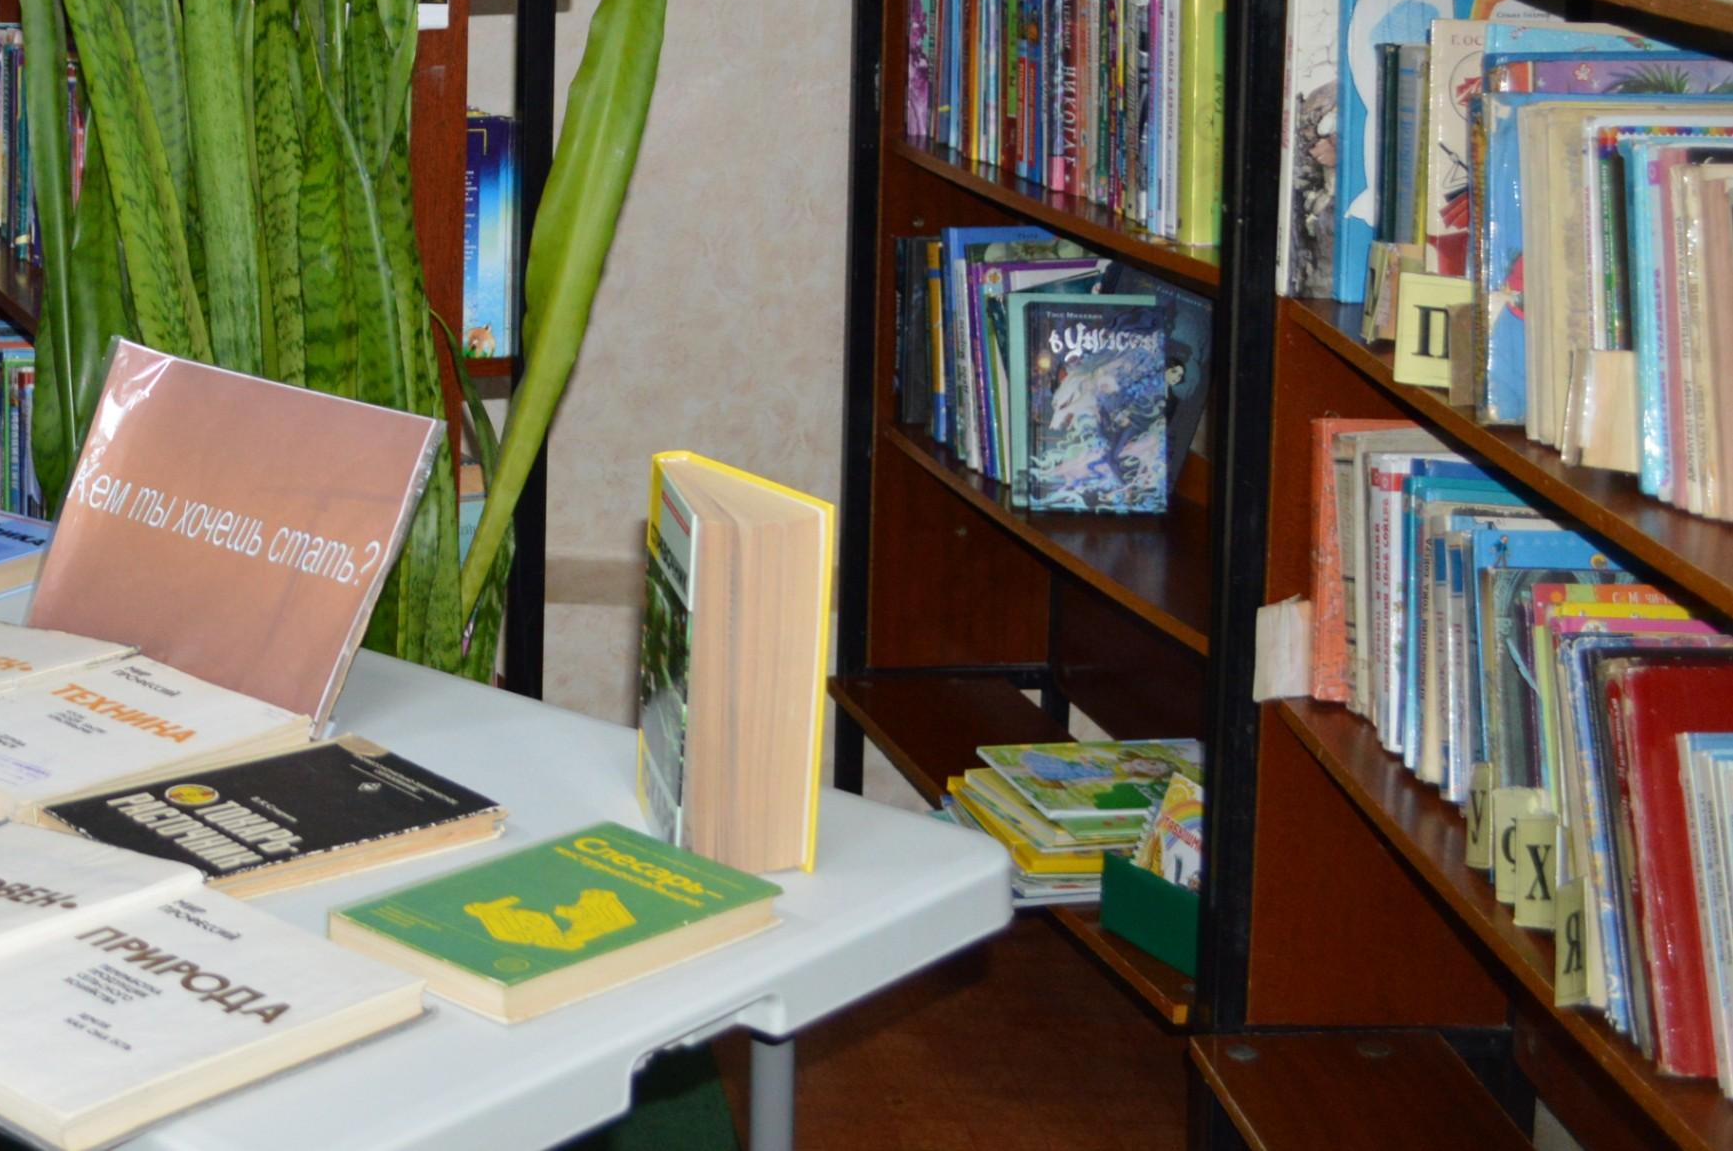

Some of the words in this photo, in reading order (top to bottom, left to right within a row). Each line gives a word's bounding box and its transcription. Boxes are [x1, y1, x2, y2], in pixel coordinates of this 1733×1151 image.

[65, 462, 129, 515] Кем
[131, 488, 173, 527] ты
[173, 499, 264, 558] хочешь
[267, 523, 383, 589] стать?
[48, 681, 197, 744] ТЕХНИКА
[105, 791, 265, 871] РАСТОЧНИК
[1469, 788, 1487, 846] У
[1525, 843, 1553, 902] Х
[73, 925, 291, 1026] ПРИРОДА
[1562, 913, 1584, 975] Я
